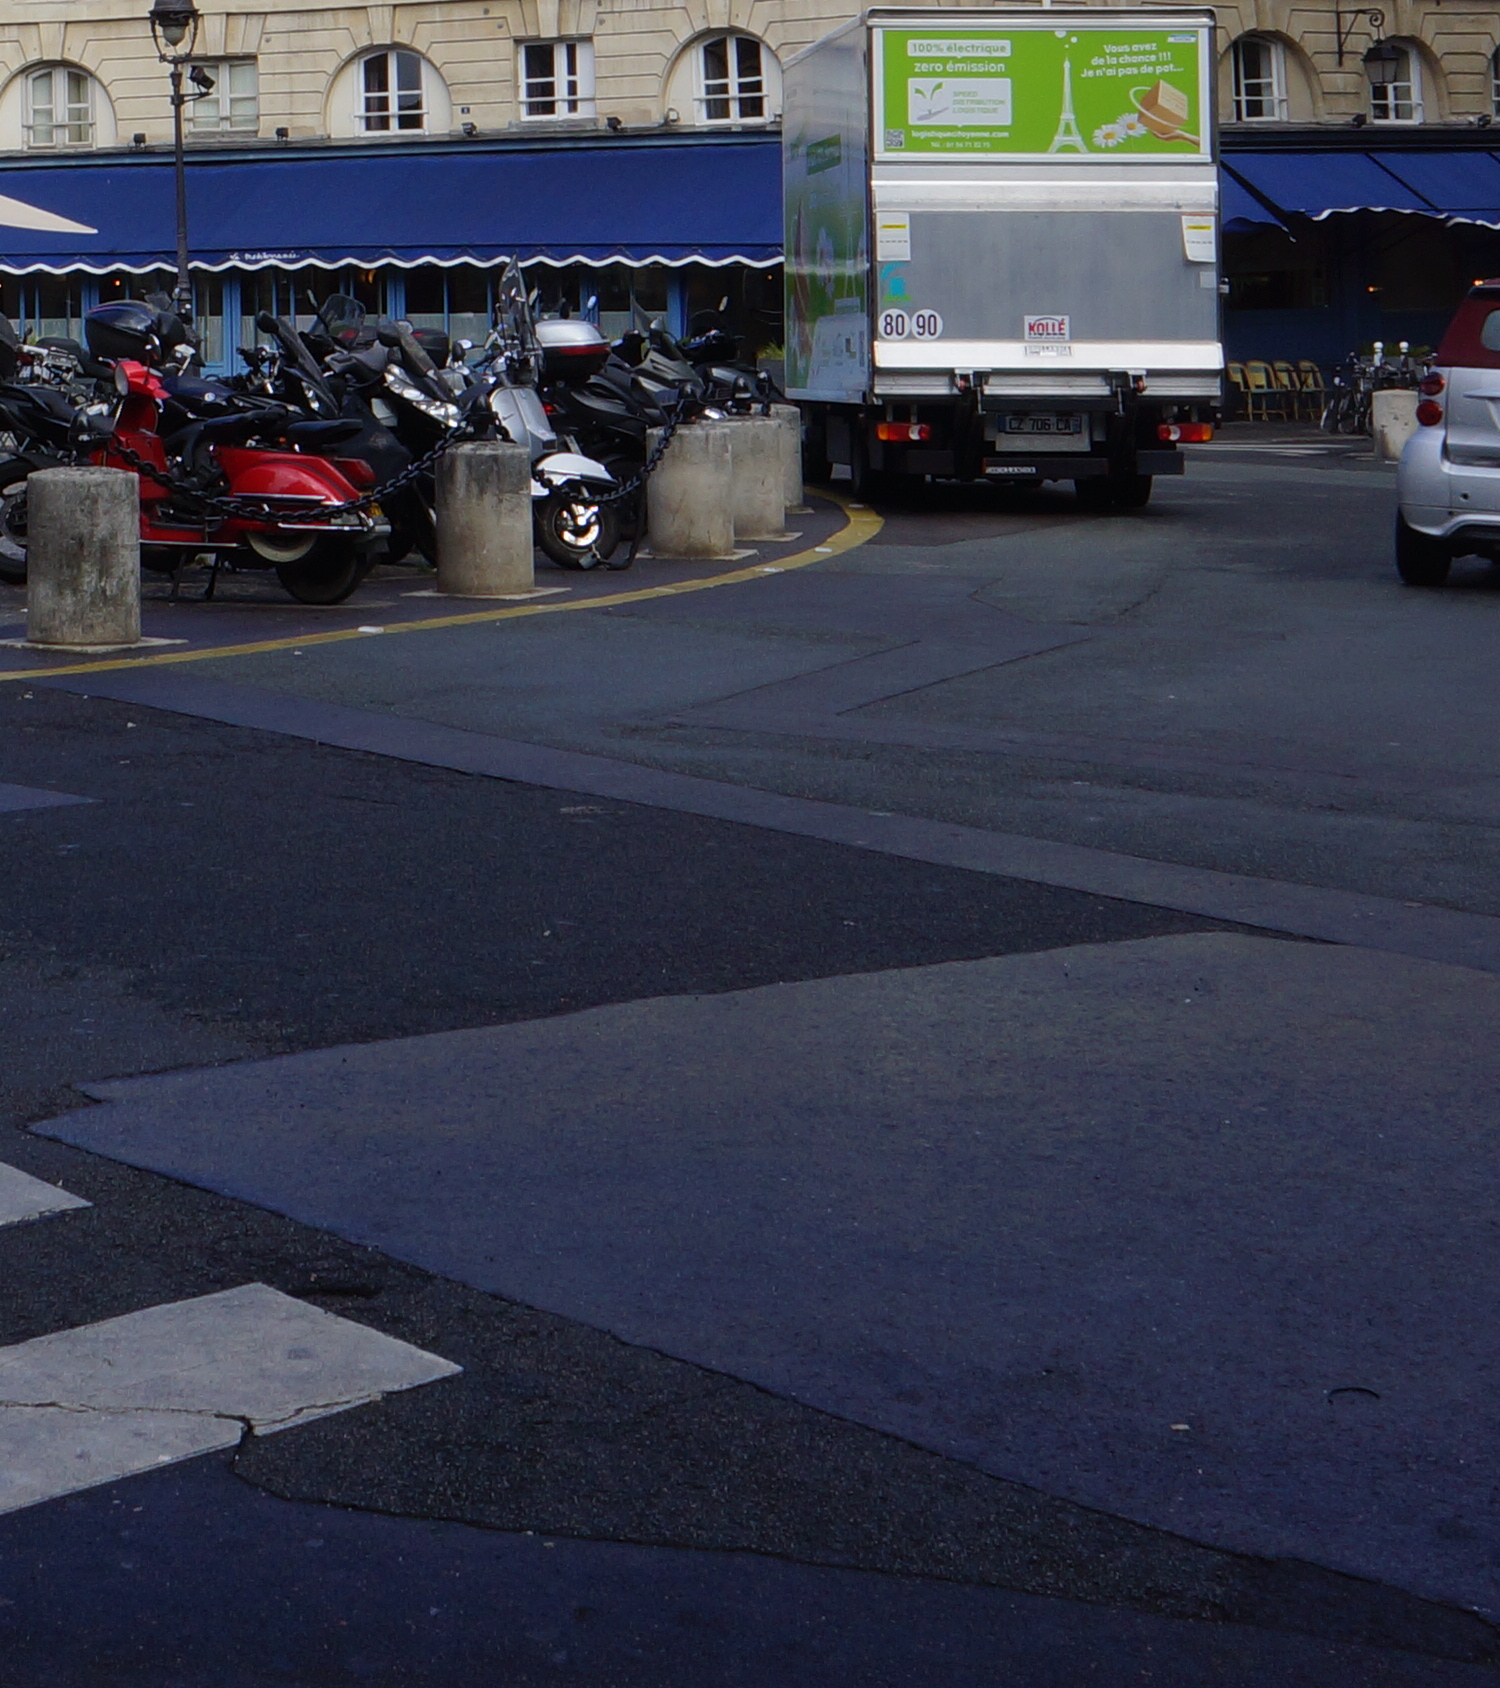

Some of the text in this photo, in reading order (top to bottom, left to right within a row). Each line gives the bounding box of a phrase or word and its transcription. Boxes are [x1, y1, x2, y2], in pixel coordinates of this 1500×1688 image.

[913, 42, 1007, 55] 100% électrique
[1103, 43, 1157, 53] Vous avez
[1091, 52, 1171, 65] de la chance !!!
[914, 60, 1006, 72] zero émission
[1081, 68, 1094, 77] Je
[1096, 67, 1116, 76] n'ai
[1118, 67, 1138, 77] pas
[1140, 64, 1154, 74] de
[884, 314, 937, 336] 80 90
